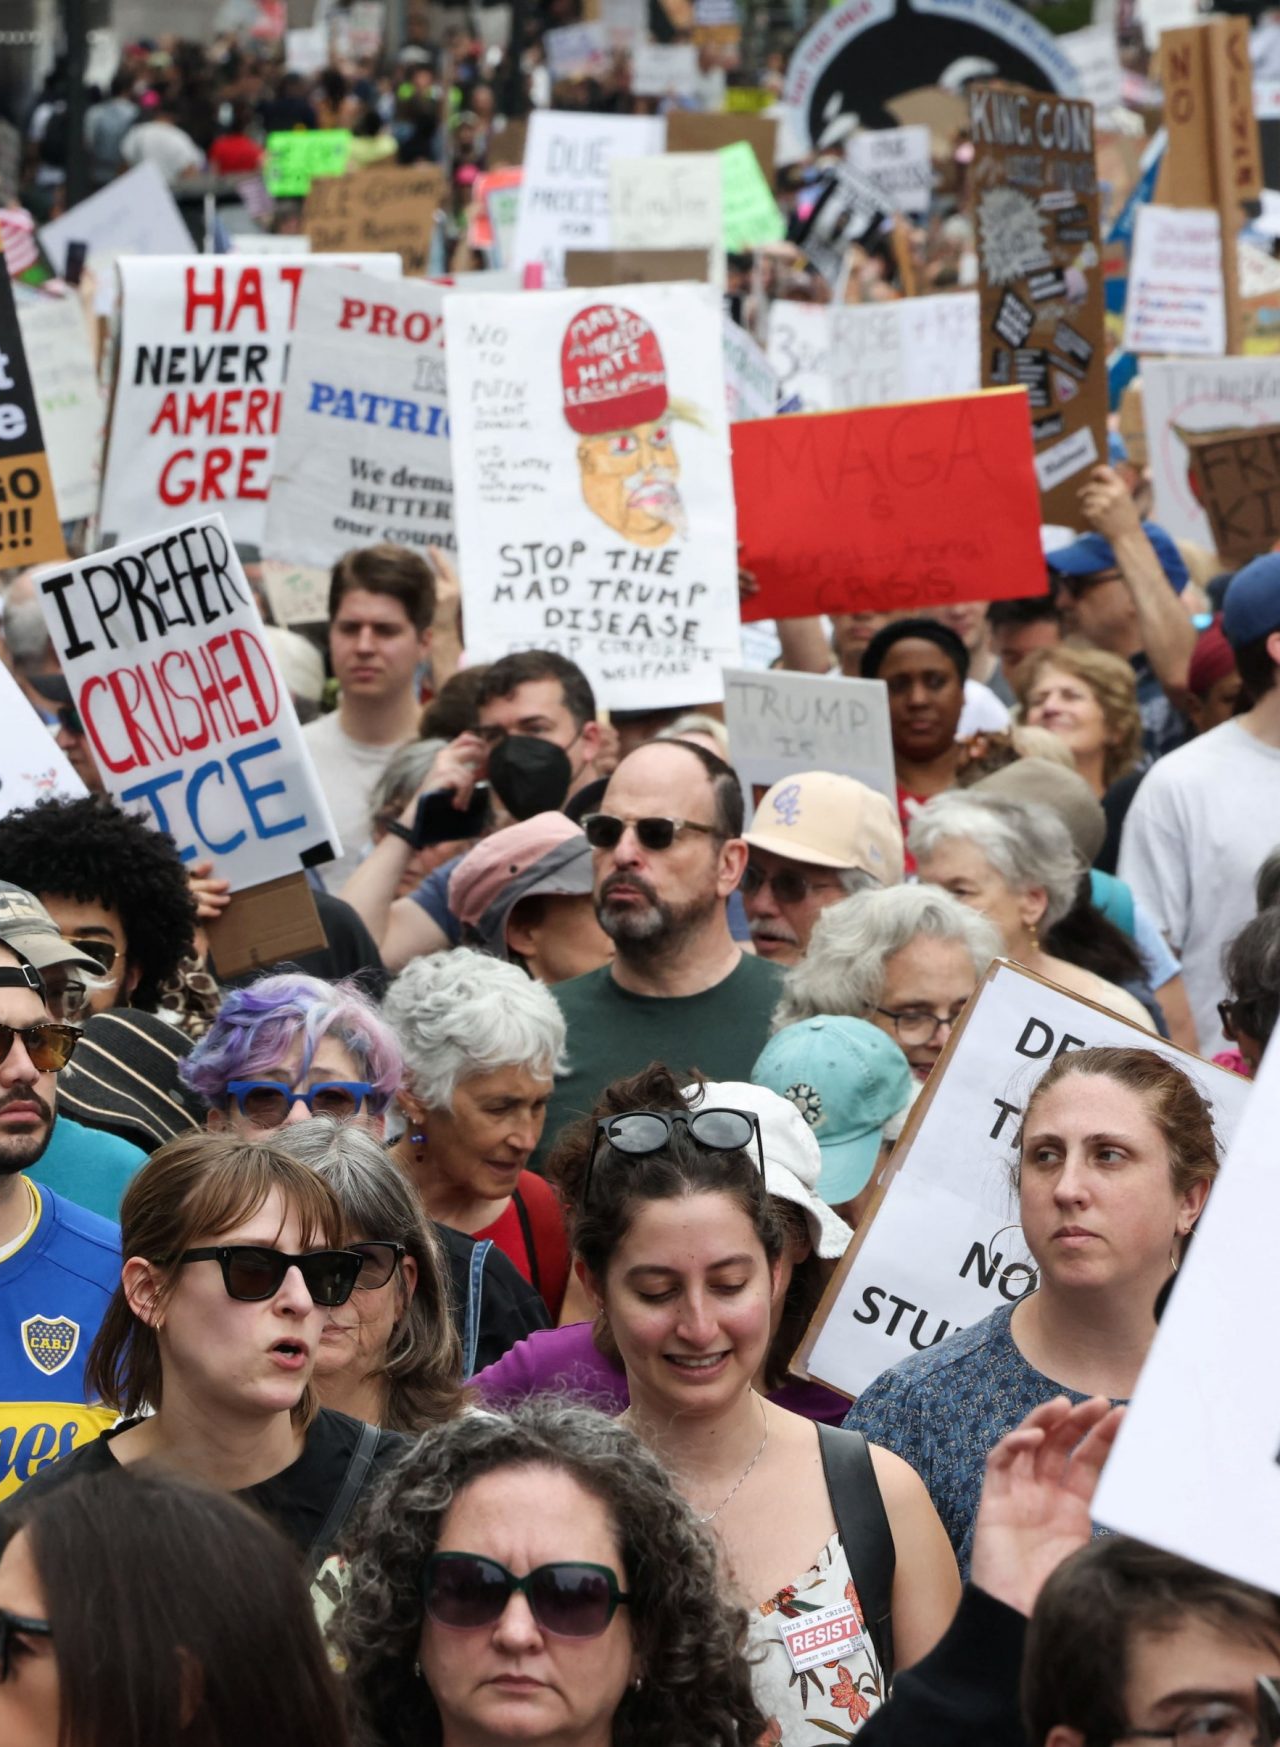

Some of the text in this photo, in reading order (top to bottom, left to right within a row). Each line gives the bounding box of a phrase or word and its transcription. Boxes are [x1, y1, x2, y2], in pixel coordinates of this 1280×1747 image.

[1035, 102, 1094, 156] CON
[466, 321, 511, 348] NO
[133, 344, 269, 386] NEVER
[148, 389, 283, 436] AMERI
[307, 381, 454, 441] PATRI
[348, 456, 387, 485] We
[763, 400, 998, 502] MAGA
[157, 448, 269, 508] GRE
[349, 489, 453, 522] BETTER
[331, 515, 377, 539] our
[498, 540, 680, 579] STOP THE
[40, 524, 250, 661] I PREFER
[492, 576, 708, 609] MAD TRUMP
[544, 608, 701, 644] DISEASE
[79, 628, 280, 775] CRUSHED
[728, 681, 871, 732] TRUMP
[120, 737, 308, 864] ICE
[29, 1335, 72, 1352] CABJ
[782, 1621, 802, 1633] THIS
[804, 1617, 814, 1626] IS
[824, 1604, 852, 1619] CRISIS
[791, 1617, 855, 1653] RESIST
